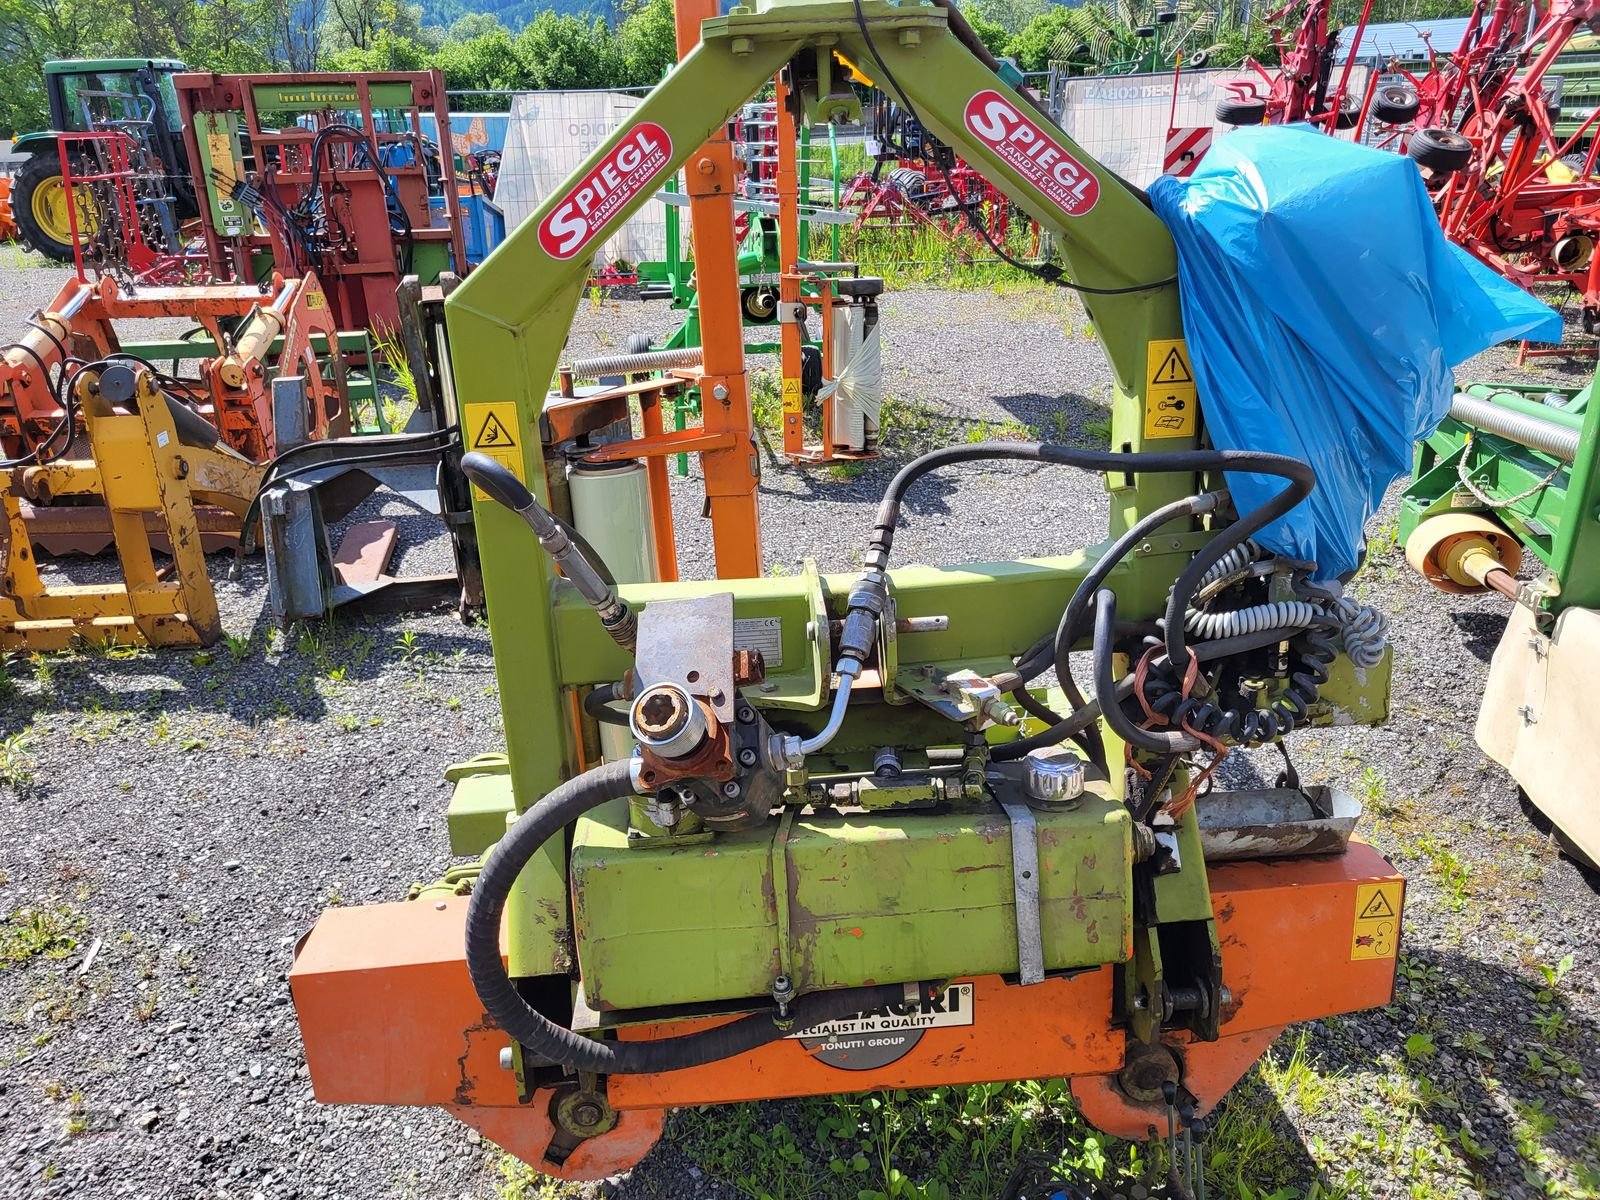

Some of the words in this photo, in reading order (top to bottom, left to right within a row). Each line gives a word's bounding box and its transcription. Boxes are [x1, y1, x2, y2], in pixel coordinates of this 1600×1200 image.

[969, 100, 1091, 201] SPIEGL
[999, 140, 1080, 208] LANDTECHNIK
[1007, 155, 1039, 182] GRAFENDORF
[549, 131, 658, 254] SPIEGL
[588, 148, 665, 226] LANDTECHNIK
[602, 191, 632, 219] GRAFENDORF
[820, 1040, 865, 1051] TONUTTI
[868, 1036, 906, 1047] GROUP
[861, 1021, 875, 1031] IN
[880, 1016, 936, 1029] QUALITY
